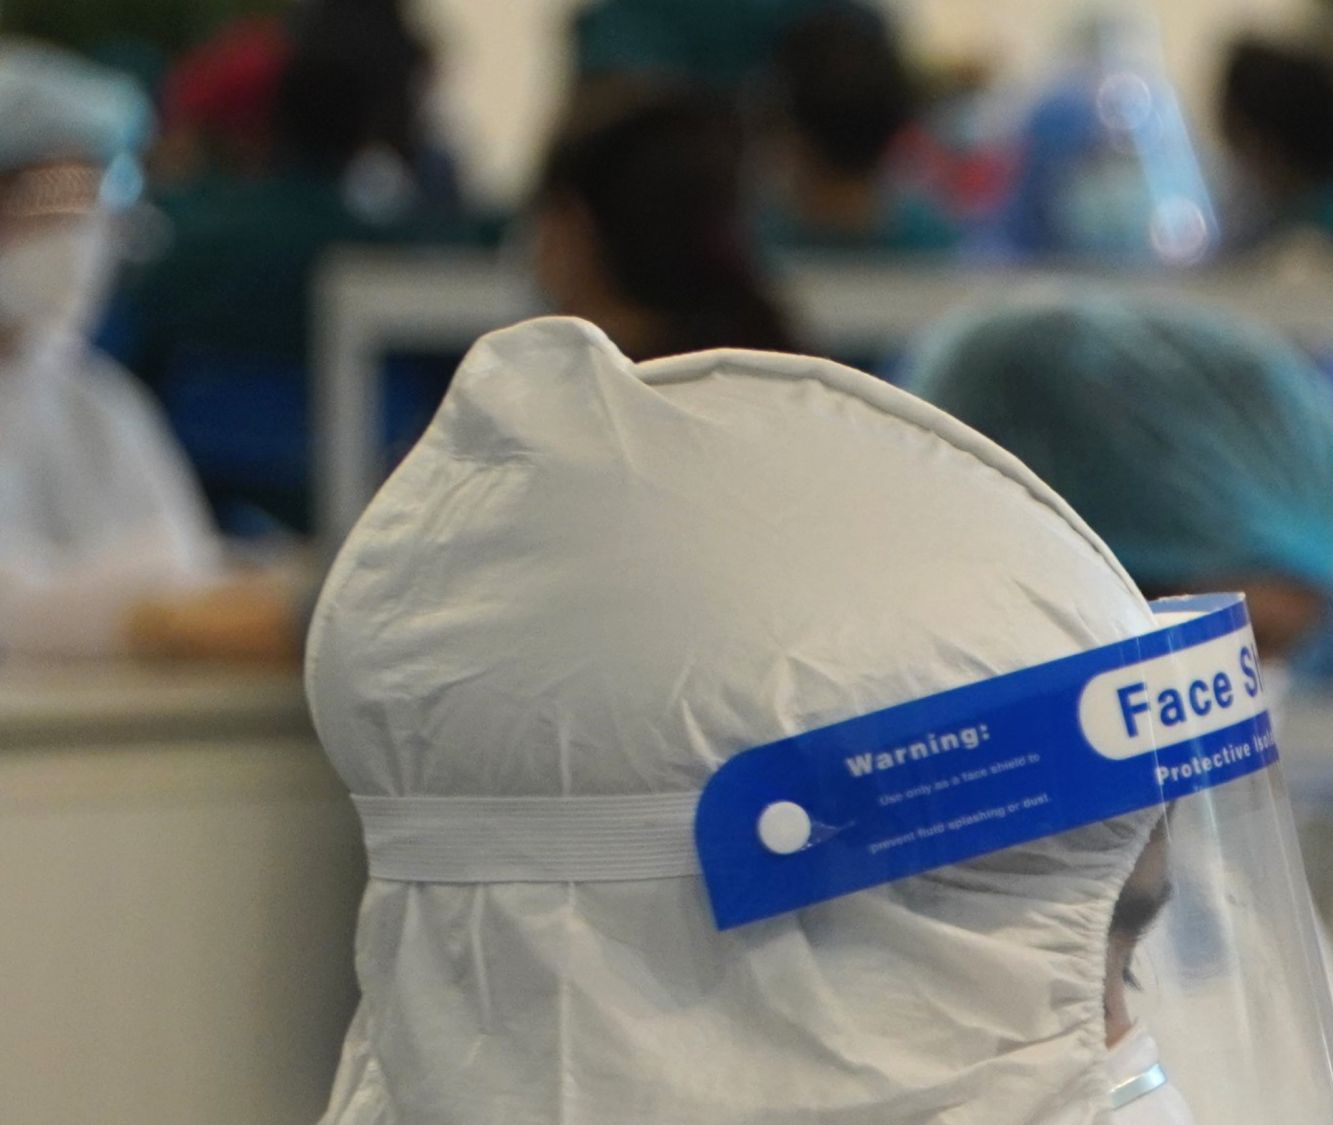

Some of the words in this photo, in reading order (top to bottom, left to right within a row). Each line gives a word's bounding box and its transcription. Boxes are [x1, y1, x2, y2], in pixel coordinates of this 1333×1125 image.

[1116, 672, 1235, 738] Face
[1239, 642, 1264, 698] S
[846, 723, 990, 777] Warning:
[1155, 742, 1251, 786] Protective
[905, 784, 933, 801] only
[961, 768, 988, 783] face
[991, 757, 1026, 775] shield
[1028, 752, 1041, 763] to
[948, 806, 1006, 831] splashing
